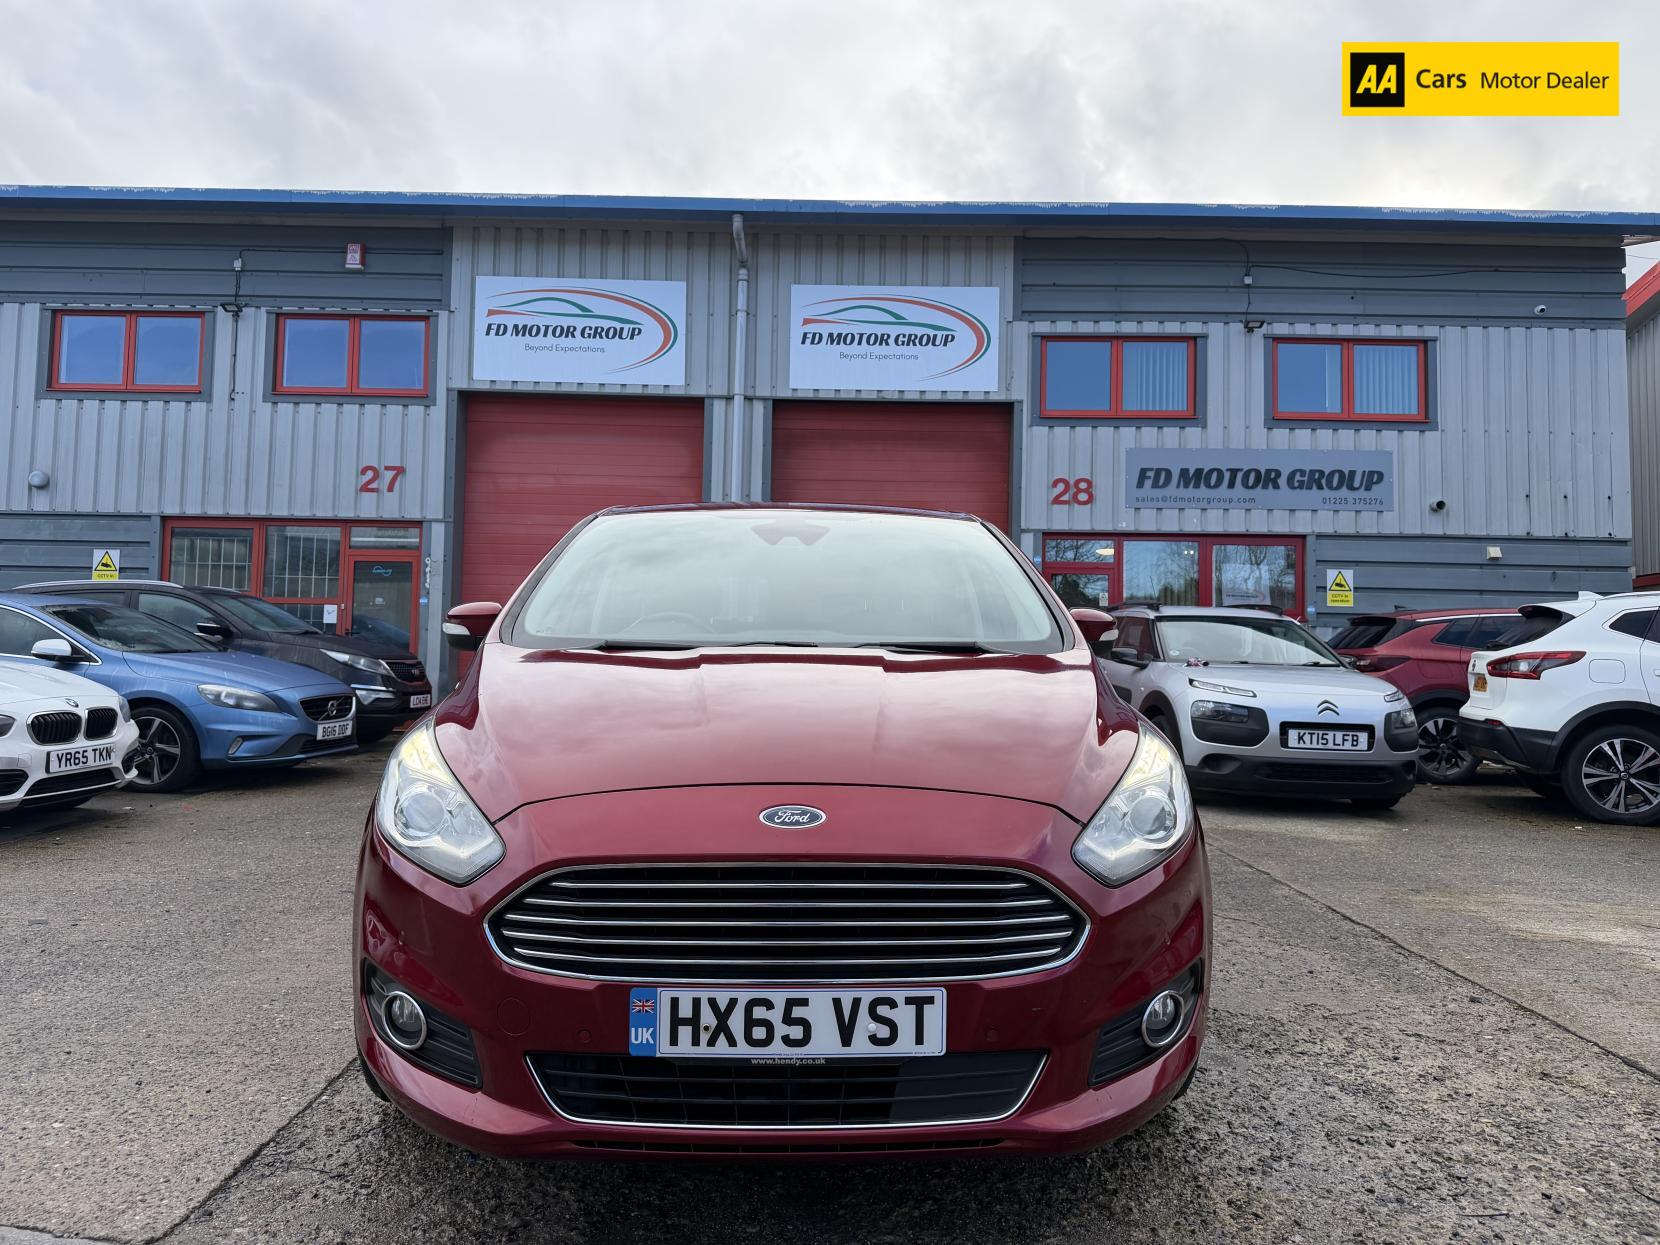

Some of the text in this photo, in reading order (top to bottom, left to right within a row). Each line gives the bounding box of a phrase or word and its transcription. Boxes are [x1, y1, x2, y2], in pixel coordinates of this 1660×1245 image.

[485, 323, 643, 341] FD MOTOR GROUP
[800, 331, 956, 347] FD MOTOR GROUP
[524, 343, 606, 354] Beyond Expectations
[839, 352, 919, 361] Beyond Expectations
[359, 465, 406, 493] 27
[1135, 467, 1384, 491] FD MOTOR GROUP
[1051, 477, 1094, 506] 28
[1135, 495, 1256, 505] sales@fdmotorgroup.com
[1322, 497, 1384, 506] 01225 375276
[321, 725, 337, 738] BG16
[1297, 731, 1359, 747] KT15 LFB
[56, 746, 112, 769] YR65 TKN
[774, 809, 811, 823] Ford
[669, 995, 936, 1048] HX65 VST
[631, 1027, 654, 1045] UK
[751, 1057, 826, 1066] www.hendy.co.uk
